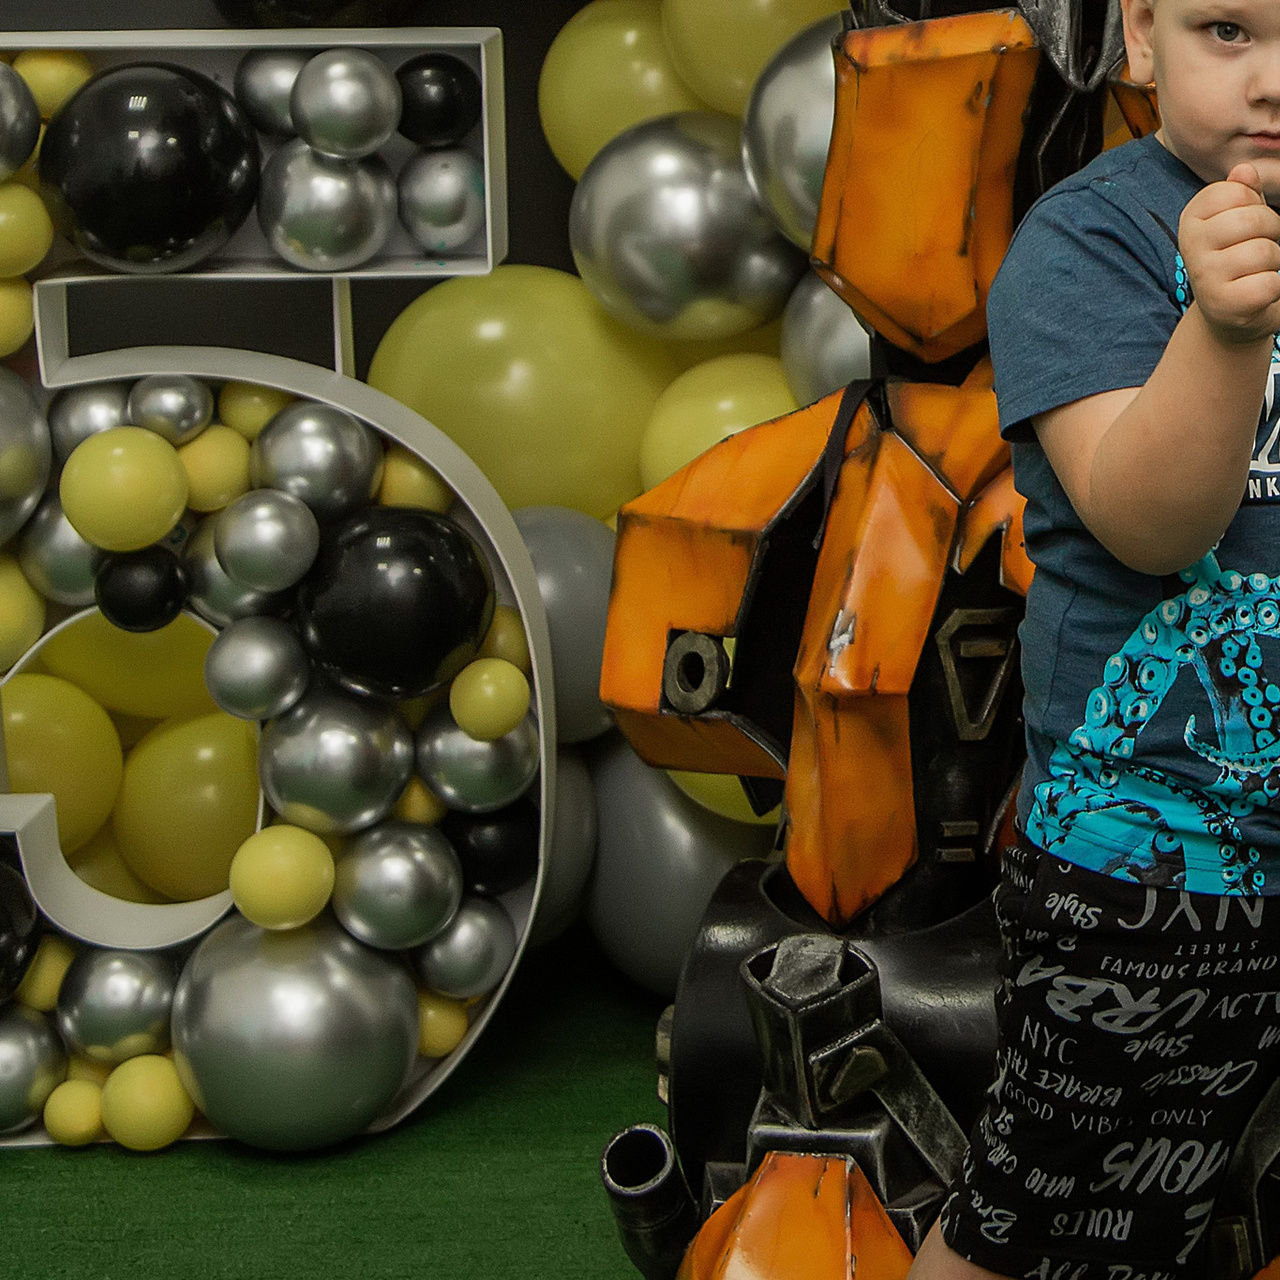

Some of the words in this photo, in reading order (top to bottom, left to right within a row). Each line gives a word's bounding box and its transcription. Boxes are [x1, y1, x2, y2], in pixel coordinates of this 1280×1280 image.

[1045, 892, 1103, 930] Style
[1174, 939, 1259, 956] STREET
[1100, 955, 1190, 981] FAMOUS
[1196, 954, 1278, 979] BRAND
[1020, 1015, 1079, 1066] NYC
[1123, 1031, 1195, 1062] Style
[1033, 1068, 1124, 1108] BRAKE
[1150, 1108, 1215, 1128] ONLY
[1024, 1167, 1076, 1199] WHO
